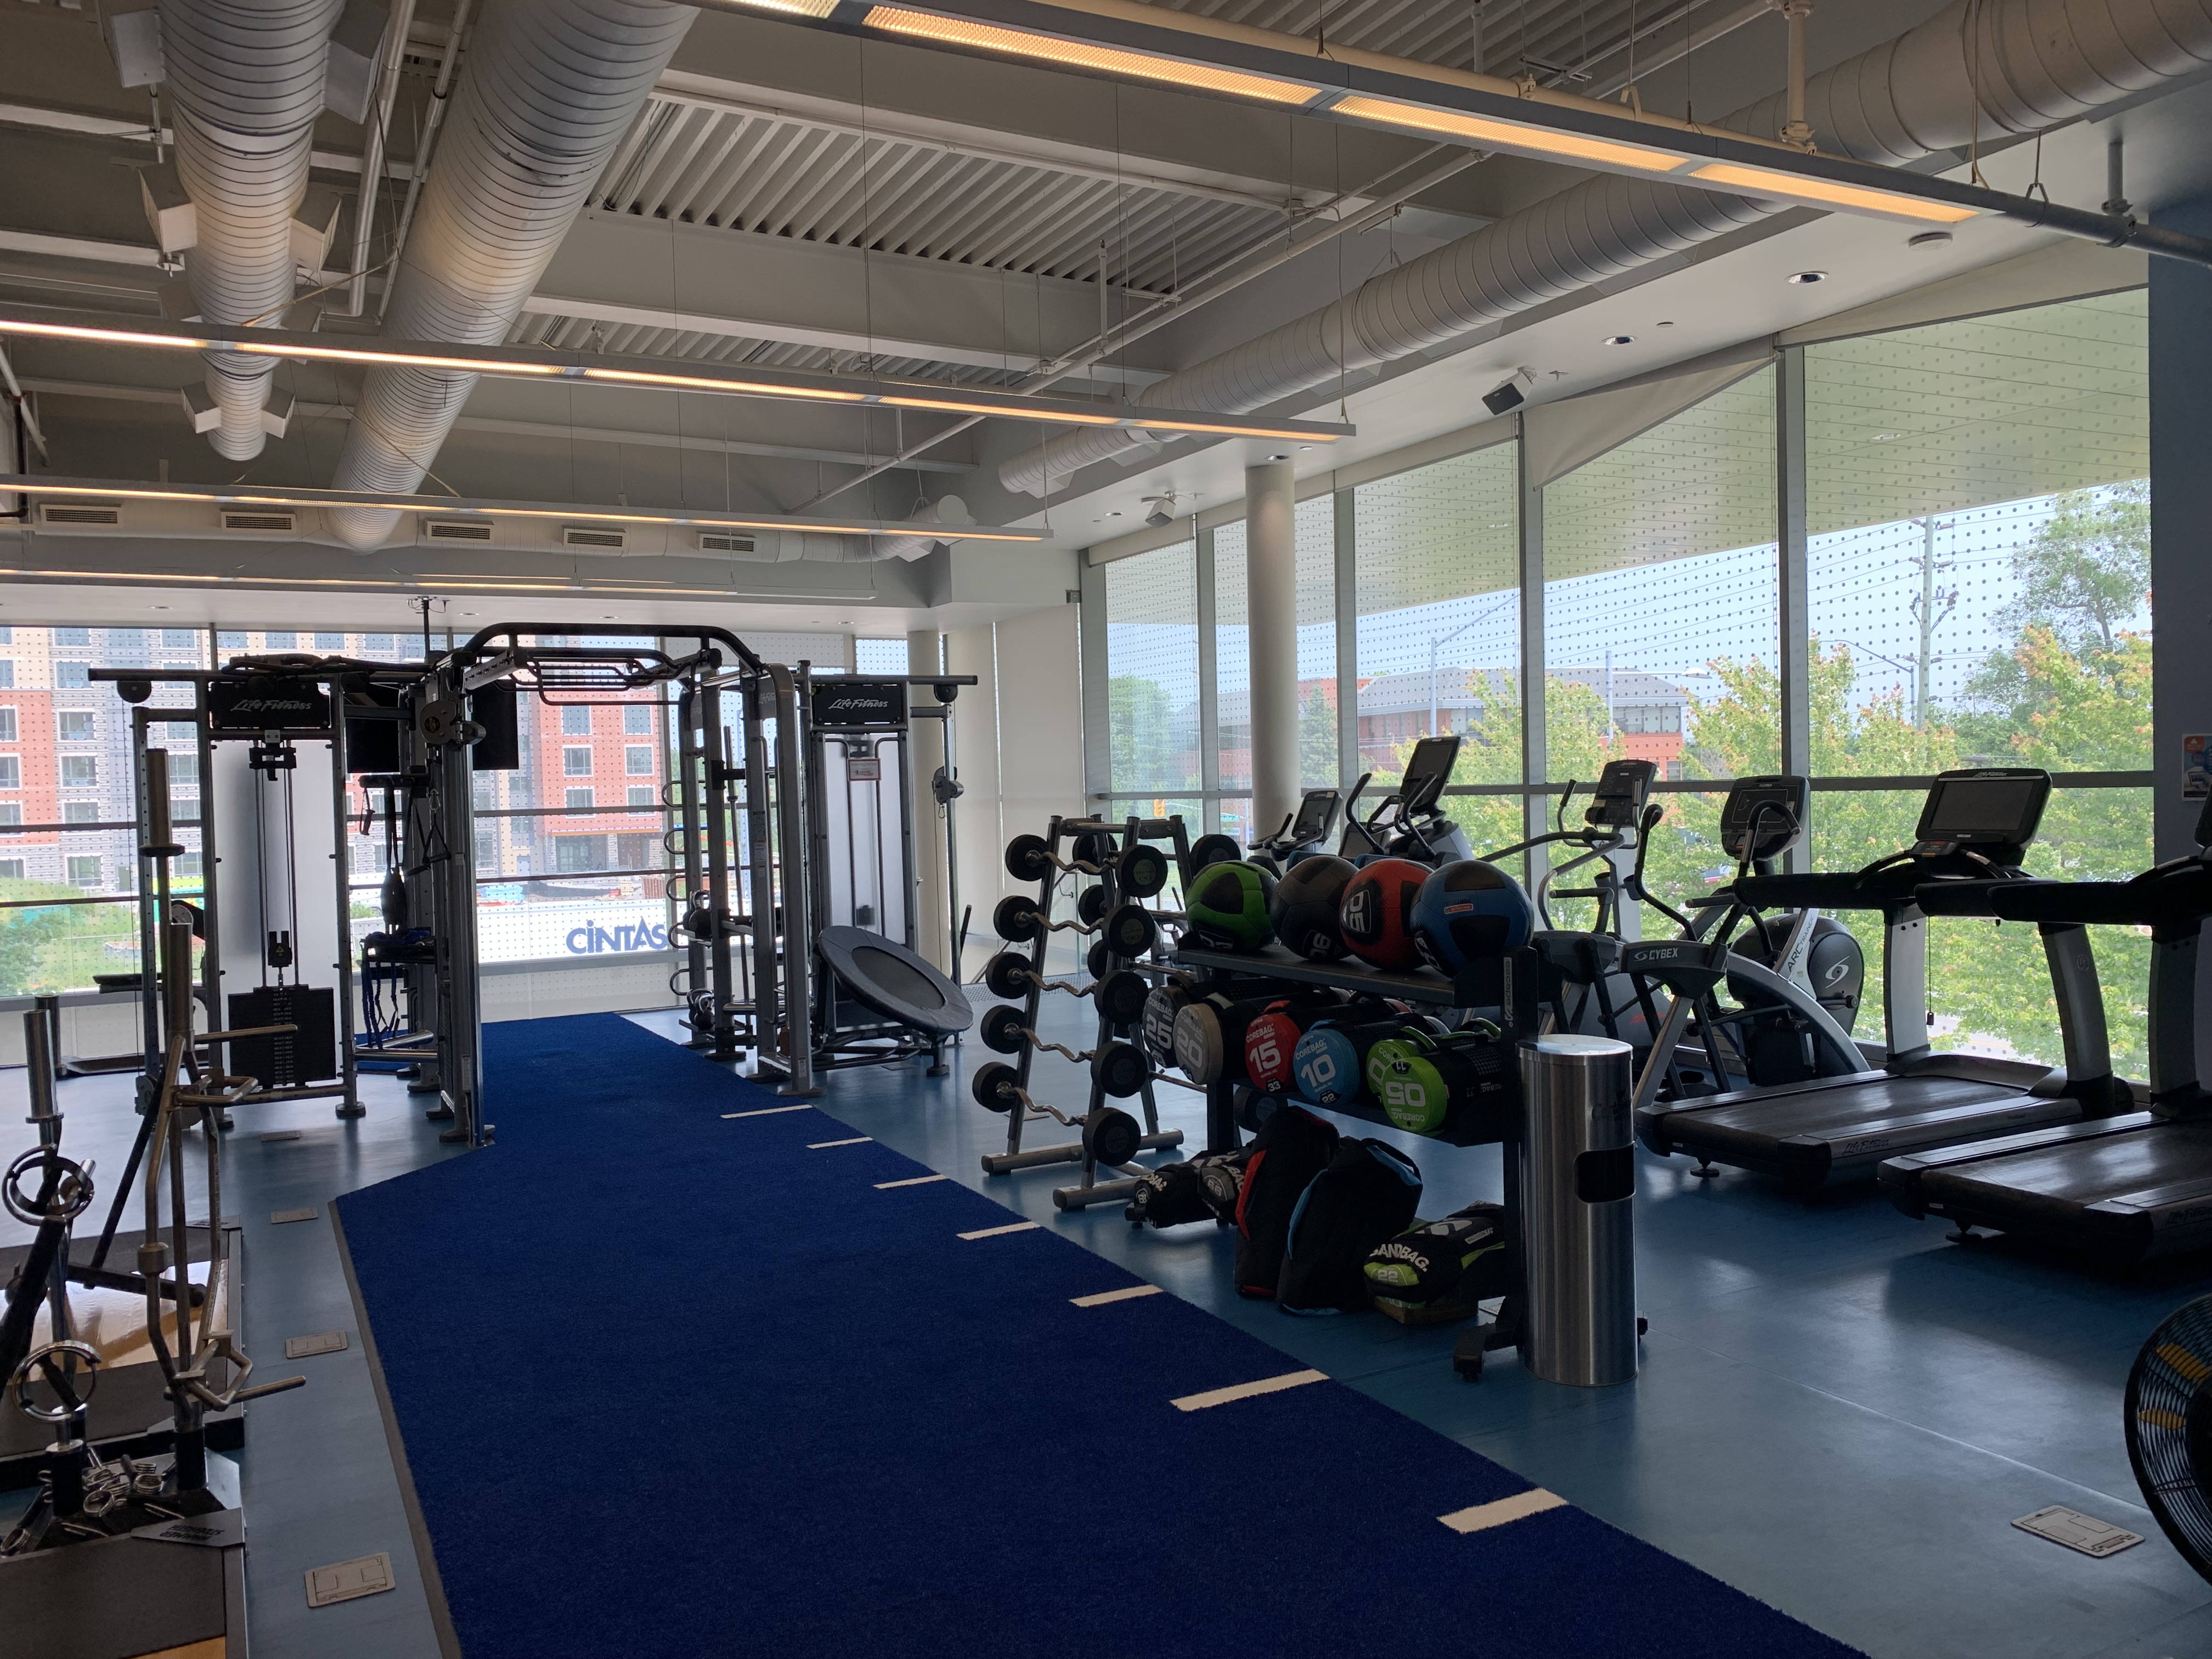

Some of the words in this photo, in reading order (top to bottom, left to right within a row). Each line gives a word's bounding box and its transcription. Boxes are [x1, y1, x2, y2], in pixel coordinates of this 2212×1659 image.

[229, 699, 262, 712] Life
[260, 699, 313, 712] Fitness
[828, 698, 851, 710] Life
[850, 698, 888, 710] Fitness
[1348, 894, 1365, 932] 05
[1787, 943, 1803, 972] ARC
[1800, 916, 1814, 945] TRAINER
[1649, 947, 1679, 960] CYBEX
[1146, 1013, 1172, 1049] 25
[1176, 1026, 1203, 1069] 20
[1249, 1039, 1281, 1073] 15
[1378, 1046, 1395, 1064] CORE
[1300, 1053, 1336, 1088] 10
[1396, 1062, 1407, 1070] 11
[1267, 1080, 1281, 1093] 33
[1385, 1081, 1426, 1107] 05
[1322, 1093, 1337, 1104] 22
[1842, 1142, 1859, 1155] Life
[1859, 1139, 1889, 1153] Fitness
[1377, 1269, 1398, 1283] 22
